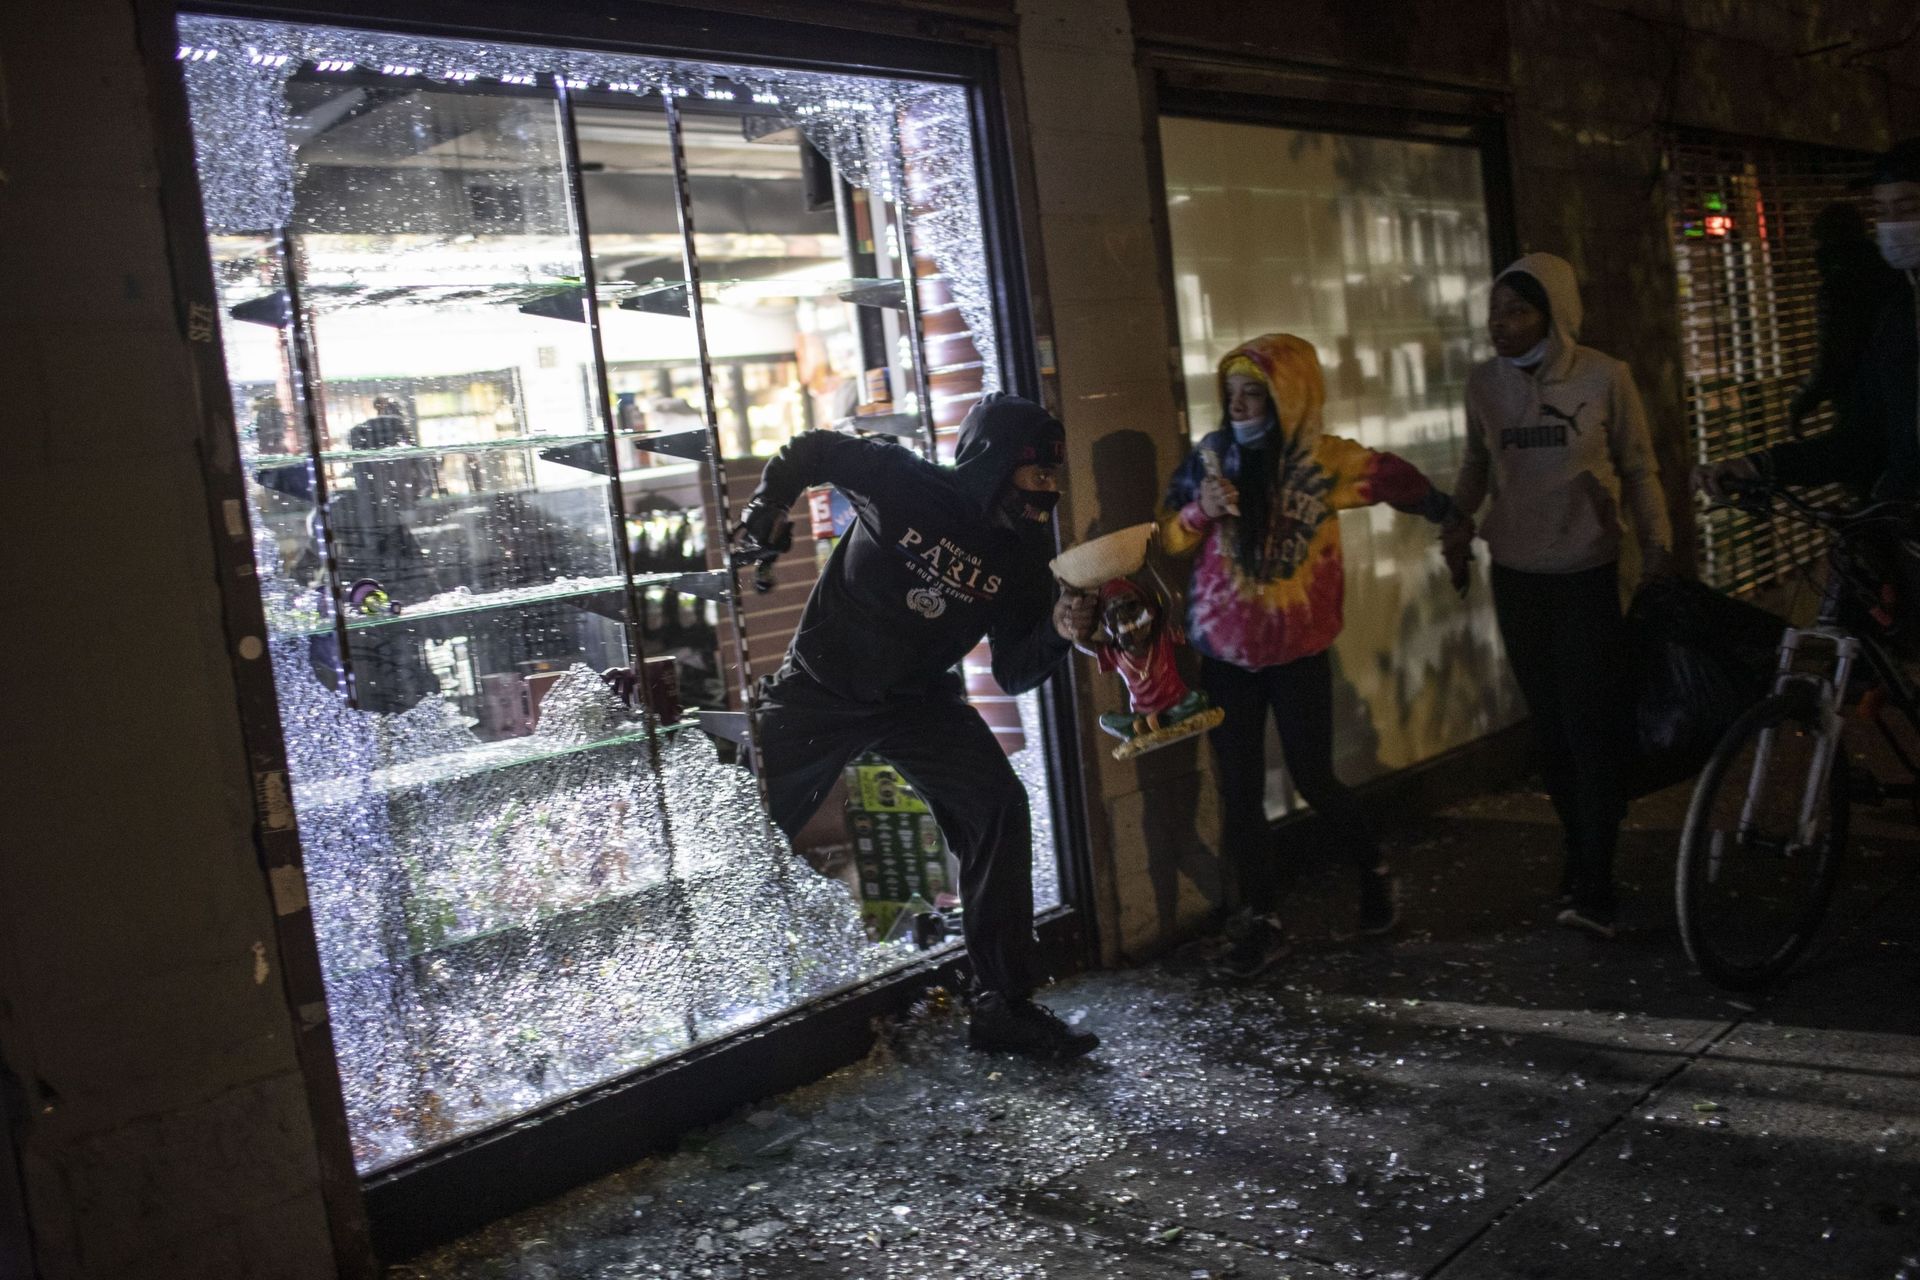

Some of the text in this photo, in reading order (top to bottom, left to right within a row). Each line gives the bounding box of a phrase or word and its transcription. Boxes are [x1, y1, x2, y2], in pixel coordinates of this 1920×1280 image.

[1501, 425, 1567, 449] PUMA
[898, 527, 1002, 594] PARIS
[916, 567, 933, 583] RUE
